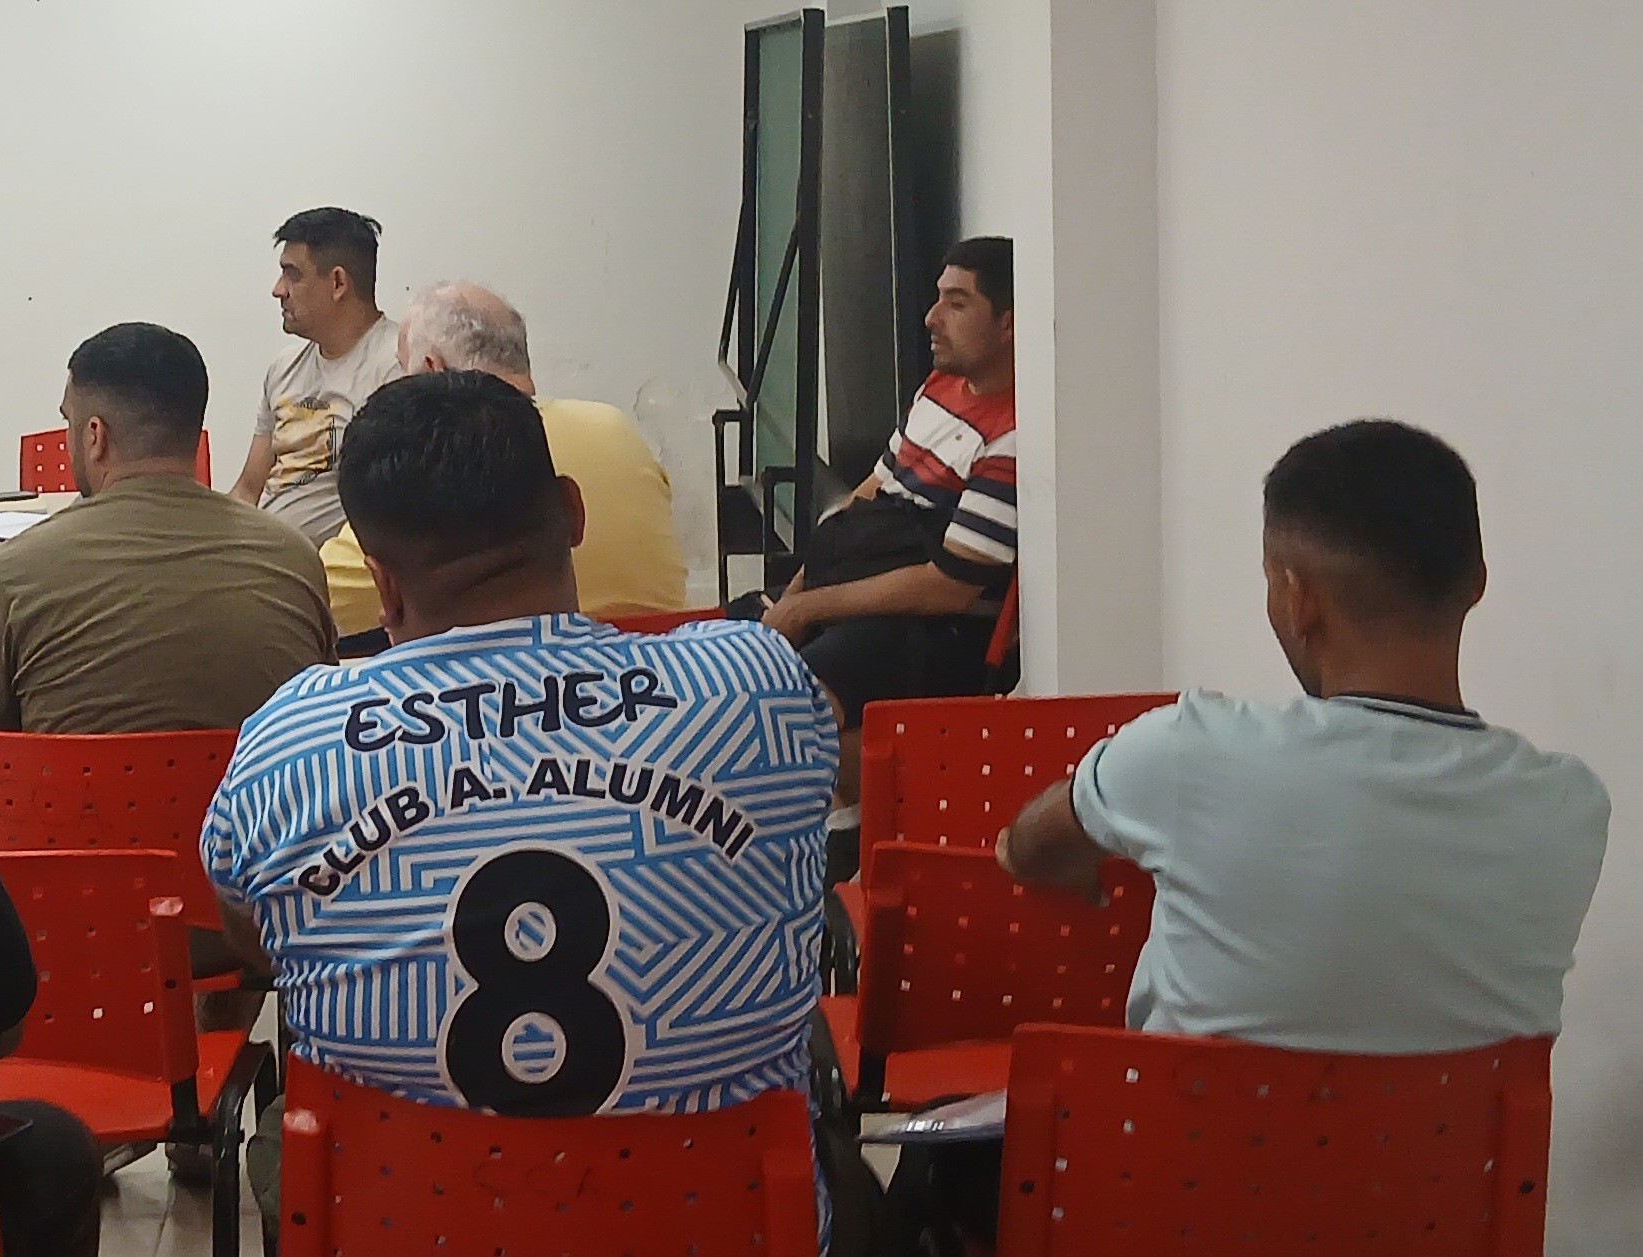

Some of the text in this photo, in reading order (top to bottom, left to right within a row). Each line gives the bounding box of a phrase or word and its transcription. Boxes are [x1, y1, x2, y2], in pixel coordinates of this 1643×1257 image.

[344, 668, 677, 752] ESTHER
[298, 758, 756, 896] CLUB A. ALUMNI
[445, 848, 627, 1117] 8
